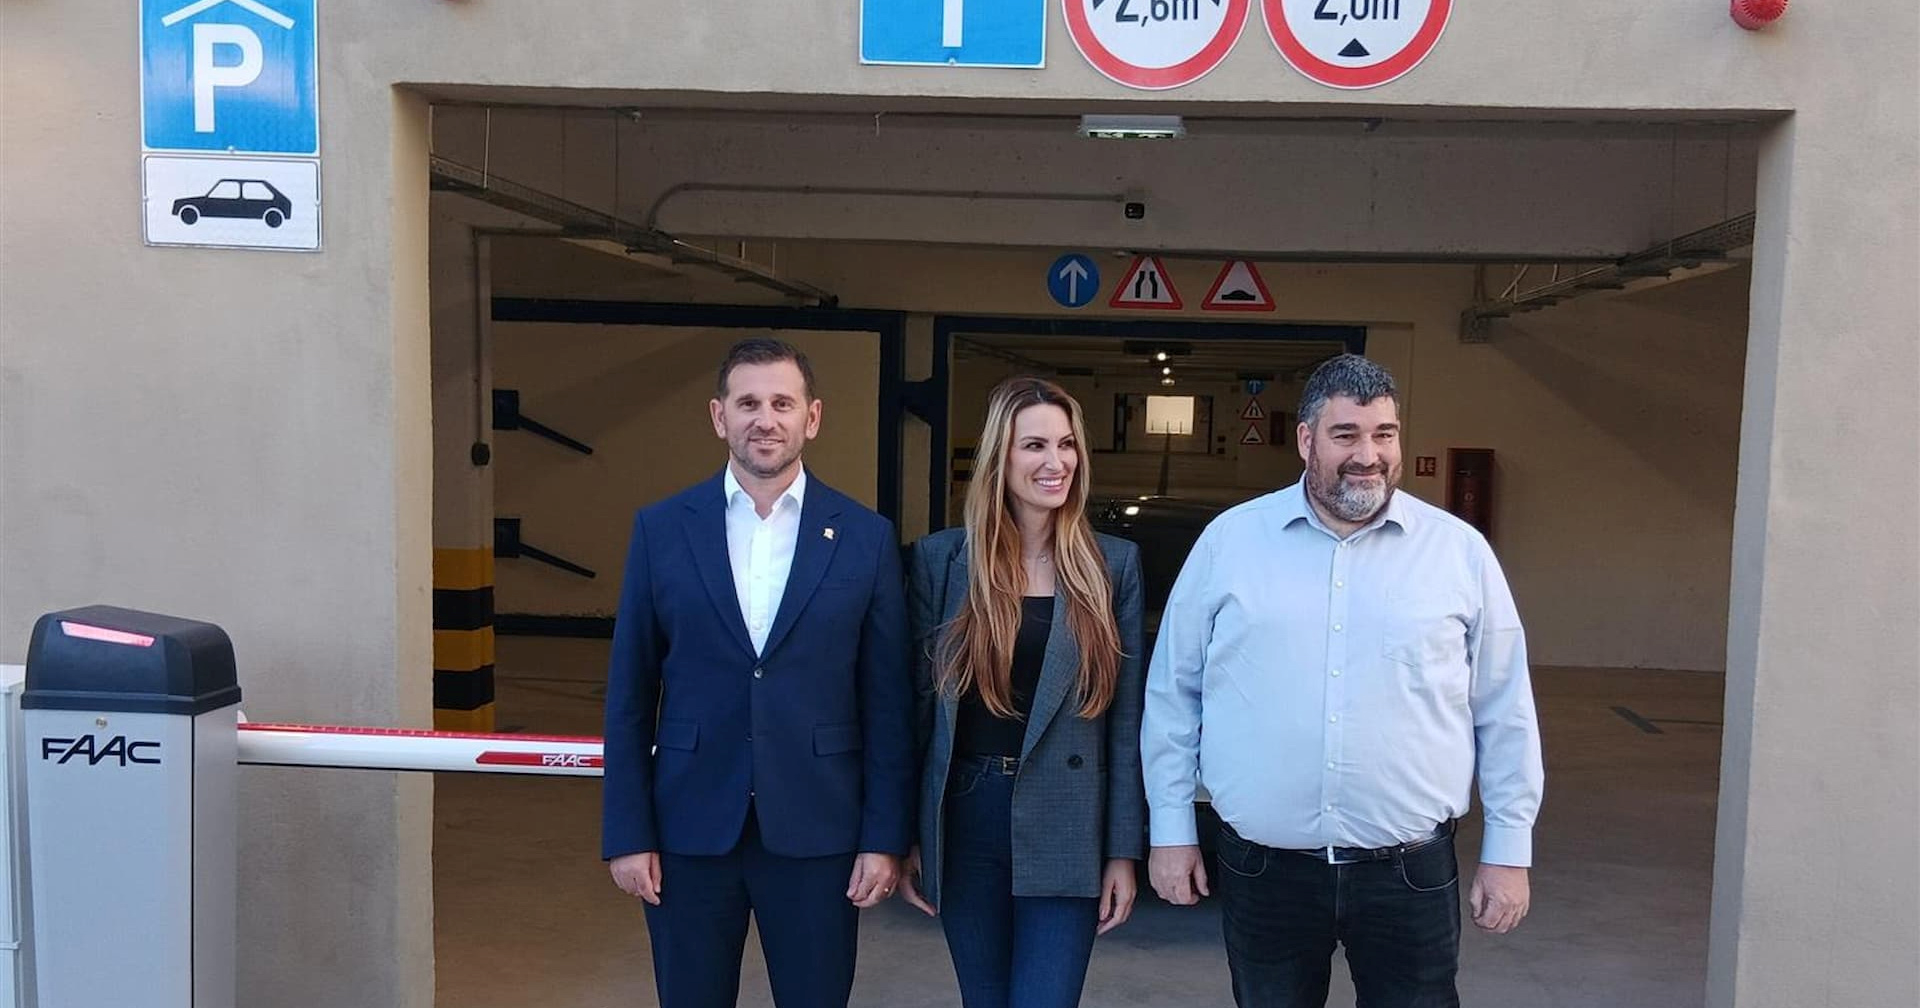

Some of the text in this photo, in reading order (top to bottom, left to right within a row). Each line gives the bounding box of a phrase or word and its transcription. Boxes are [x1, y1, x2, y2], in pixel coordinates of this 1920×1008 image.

[193, 23, 264, 133] P
[42, 734, 161, 767] FAAC
[542, 754, 592, 767] FAAC
